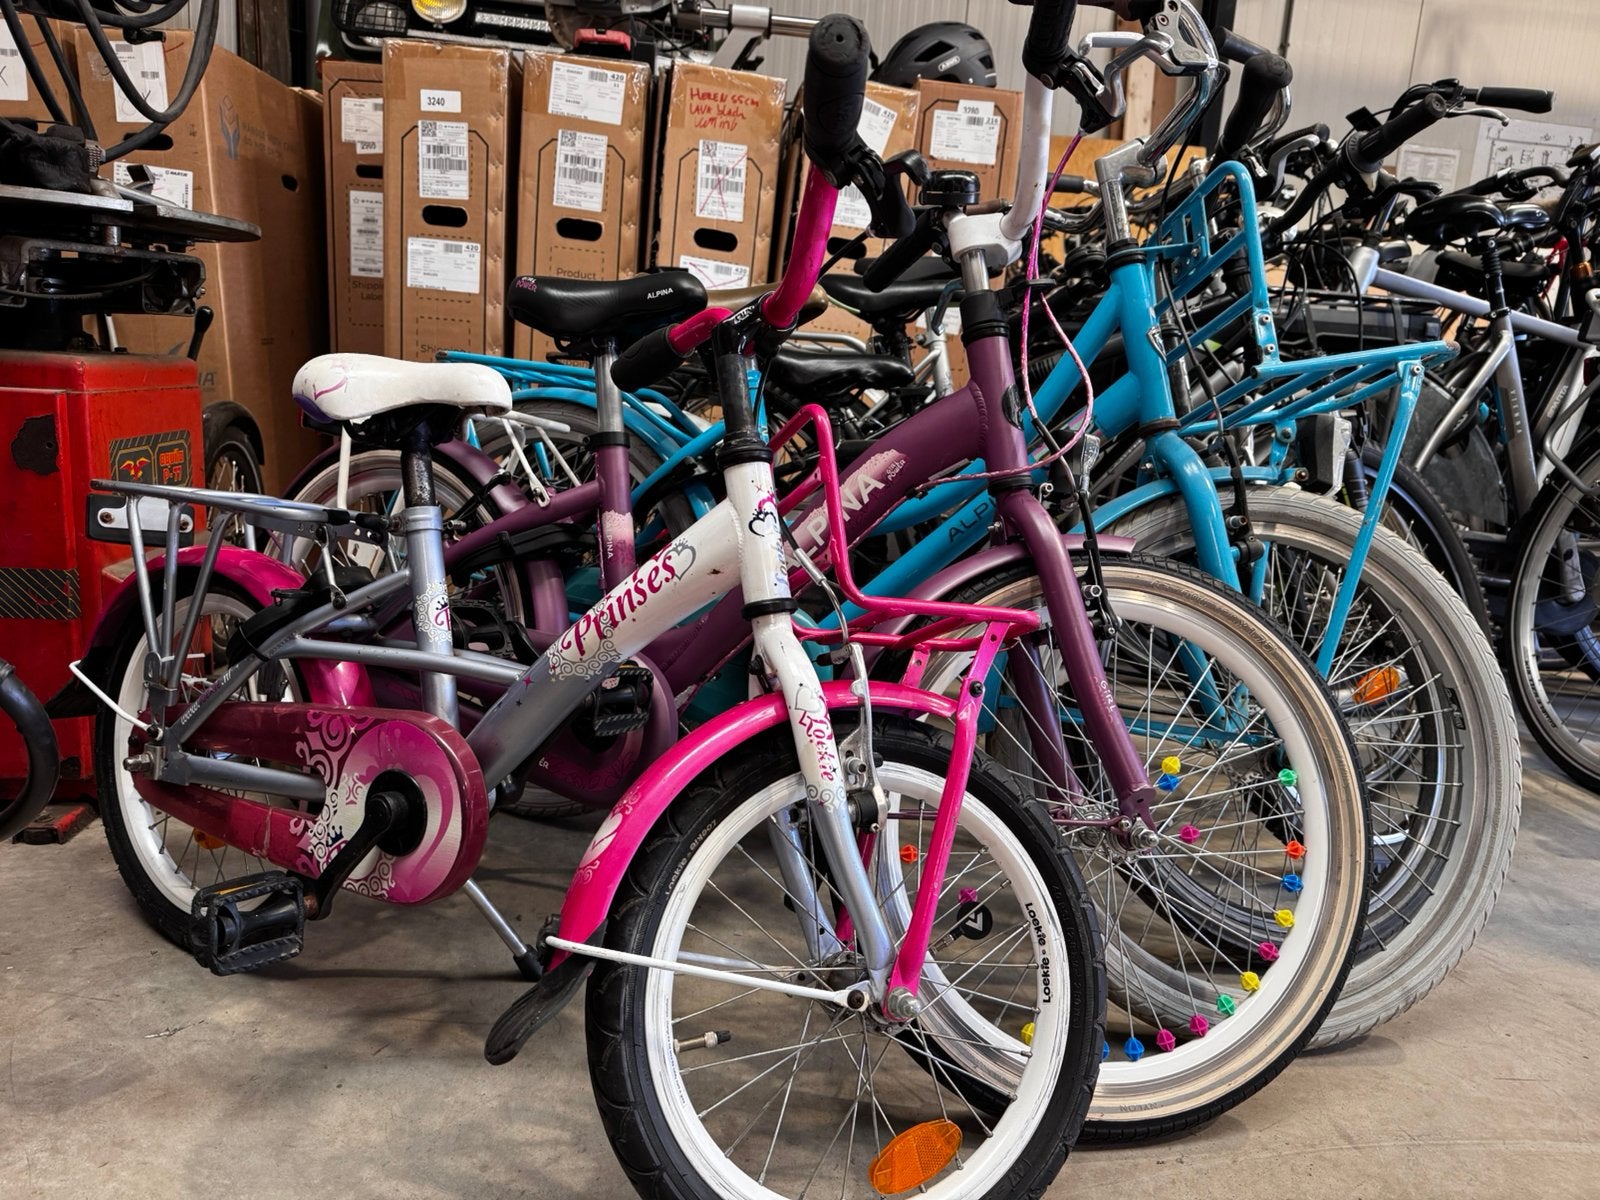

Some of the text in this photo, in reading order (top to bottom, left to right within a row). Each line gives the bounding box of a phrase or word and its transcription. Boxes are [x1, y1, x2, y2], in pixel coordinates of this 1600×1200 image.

[427, 97, 446, 106] 3240
[556, 267, 597, 280] Product
[352, 280, 384, 290] Shippi
[647, 287, 674, 300] ALPINA
[360, 292, 384, 301] Labe
[949, 497, 997, 543] ALPI
[560, 548, 678, 658] Prinses
[690, 819, 718, 851] Loekie
[1024, 902, 1047, 946] Loekie
[1041, 958, 1051, 1004] Loekie
